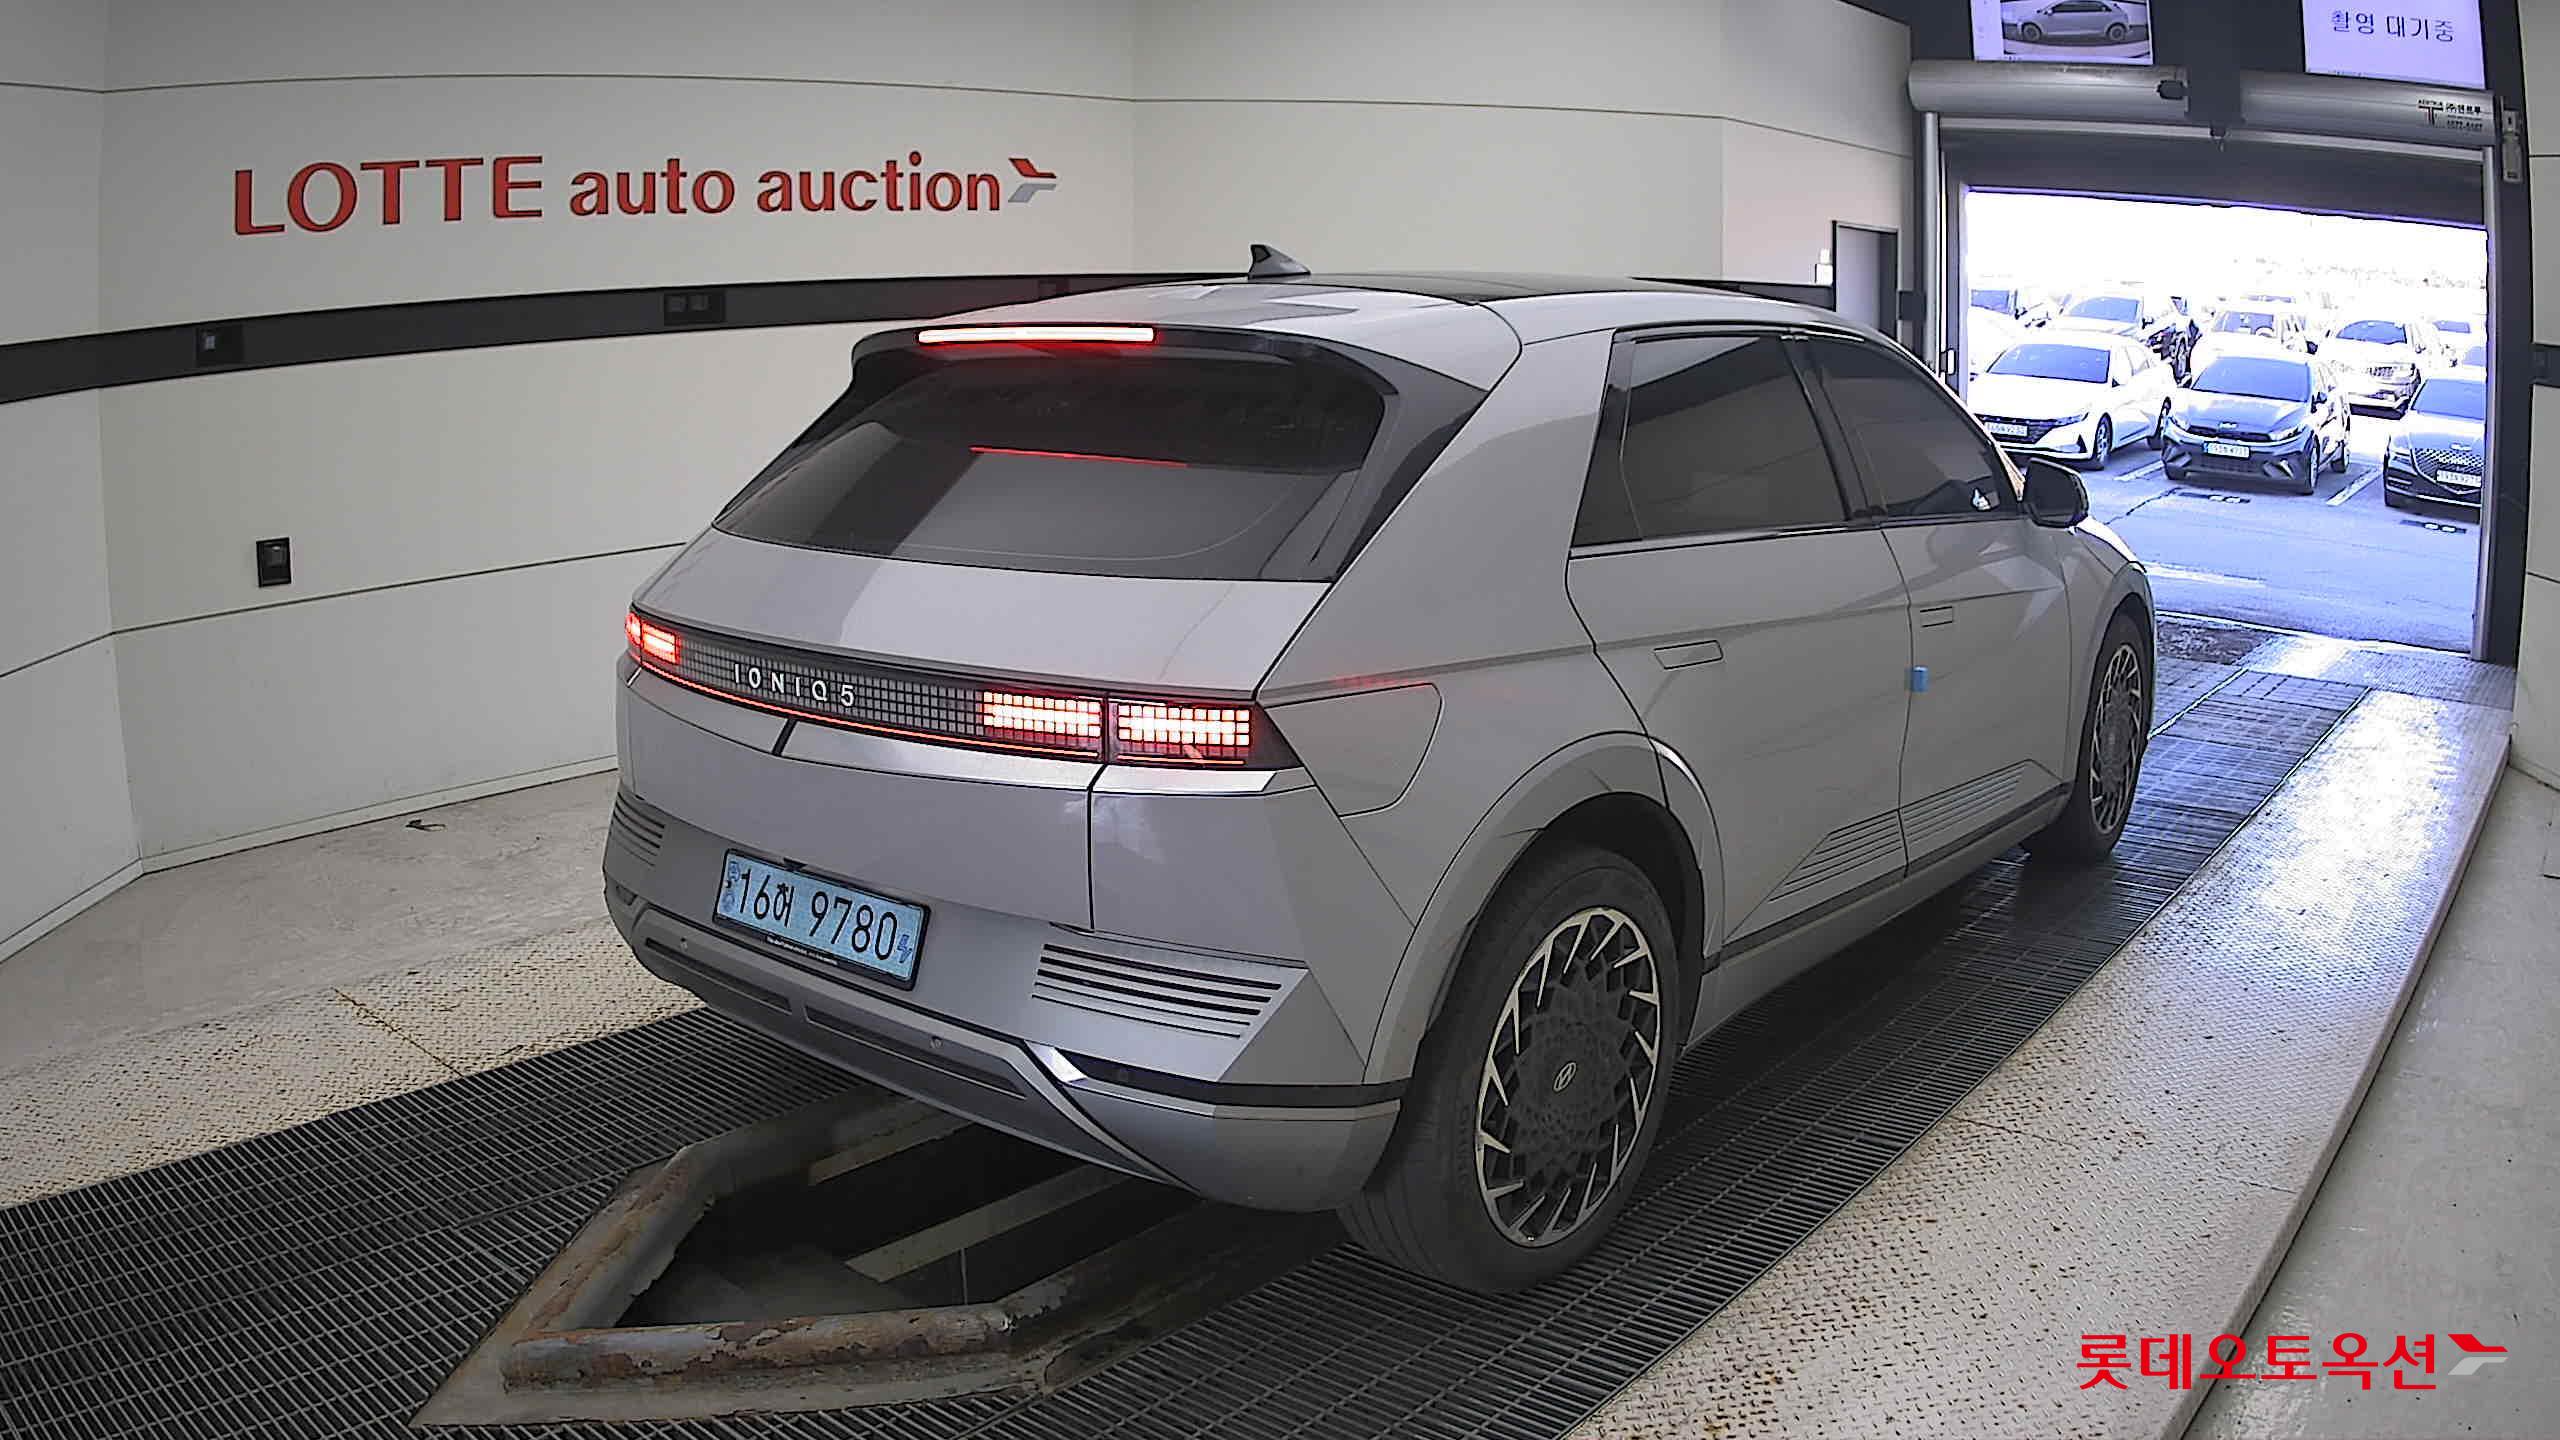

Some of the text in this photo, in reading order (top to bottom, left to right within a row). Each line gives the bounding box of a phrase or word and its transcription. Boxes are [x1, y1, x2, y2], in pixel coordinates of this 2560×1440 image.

[2331, 10, 2453, 43] 촬영 대기중
[235, 150, 1002, 236] LOTTE auto auction
[734, 663, 855, 707] IONIQ 5
[739, 868, 795, 928] 16허
[808, 891, 899, 961] 9780
